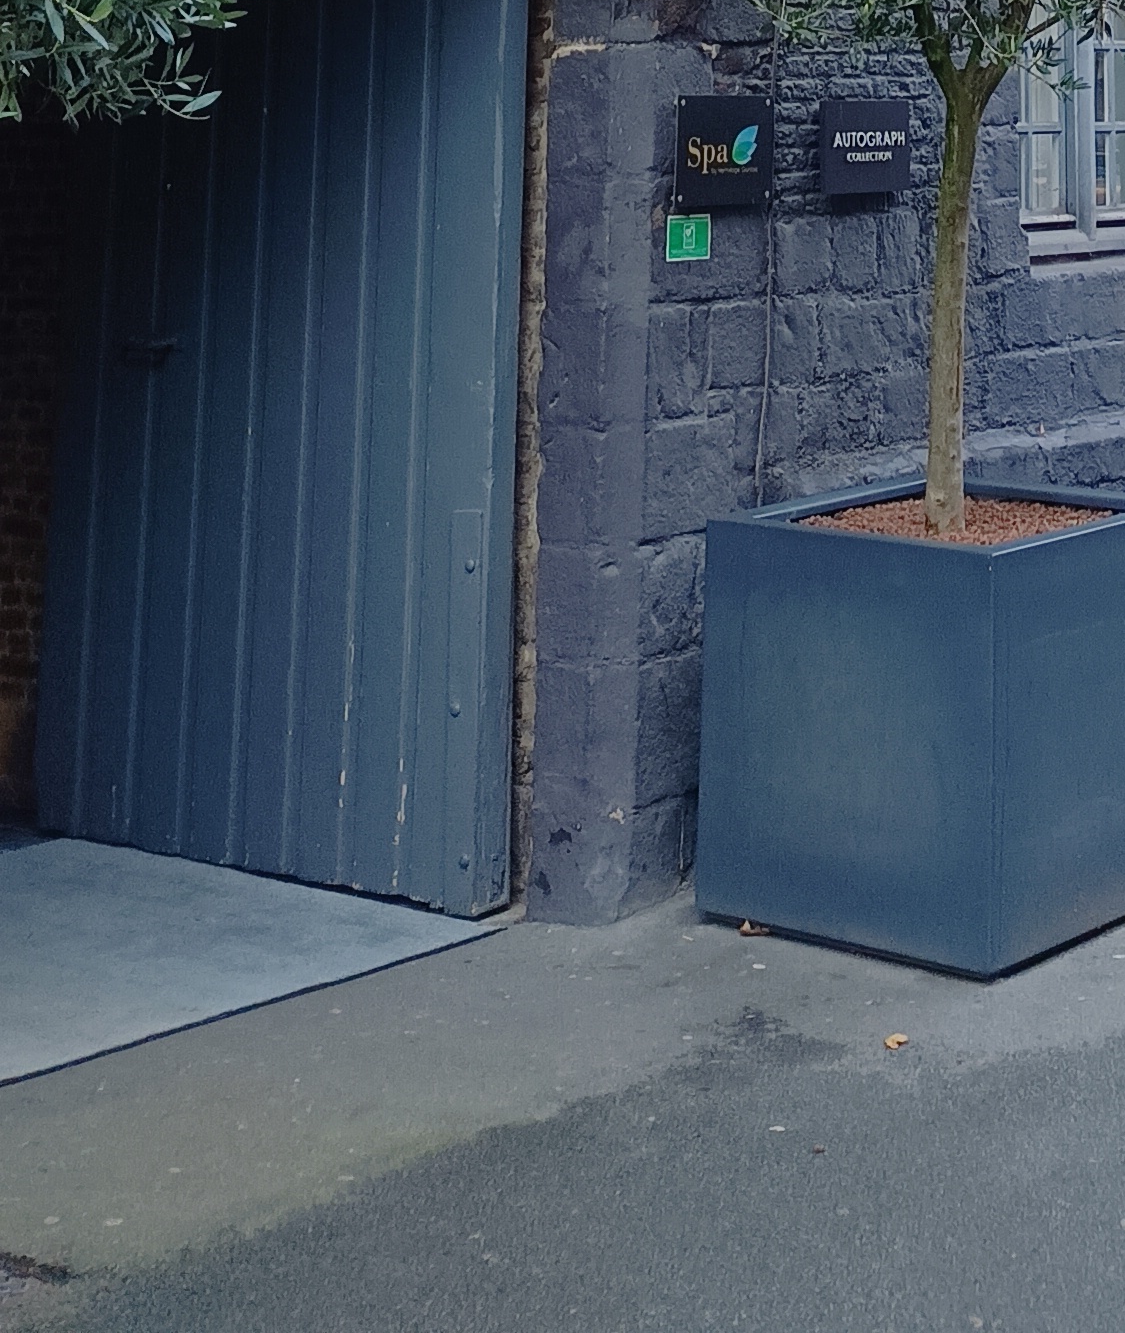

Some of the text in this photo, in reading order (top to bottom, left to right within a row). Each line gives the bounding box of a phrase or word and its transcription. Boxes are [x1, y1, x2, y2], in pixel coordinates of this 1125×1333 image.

[833, 131, 906, 148] AUTOGRAPH
[687, 137, 728, 174] Spa
[846, 150, 893, 163] COLLECTION
